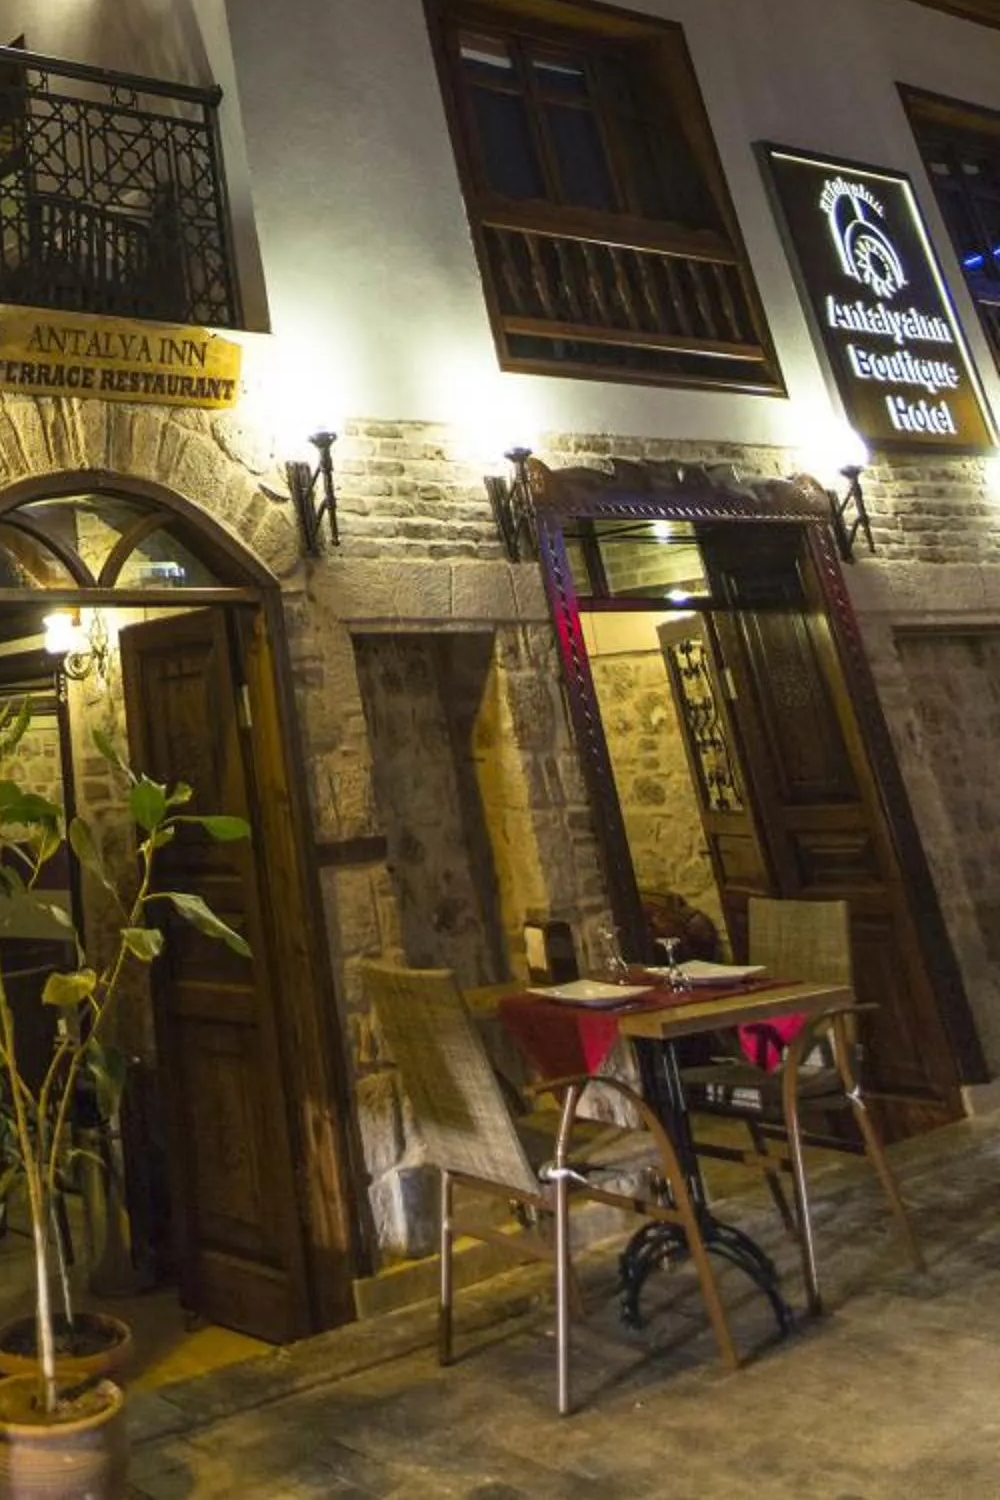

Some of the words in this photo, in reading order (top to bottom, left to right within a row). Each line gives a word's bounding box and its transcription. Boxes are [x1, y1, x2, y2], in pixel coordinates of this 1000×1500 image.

[25, 323, 152, 365] ANTALYA
[158, 337, 208, 368] INN
[99, 363, 236, 401] RESTAURANT
[847, 344, 960, 395] Boutique
[885, 395, 956, 435] Hotel
